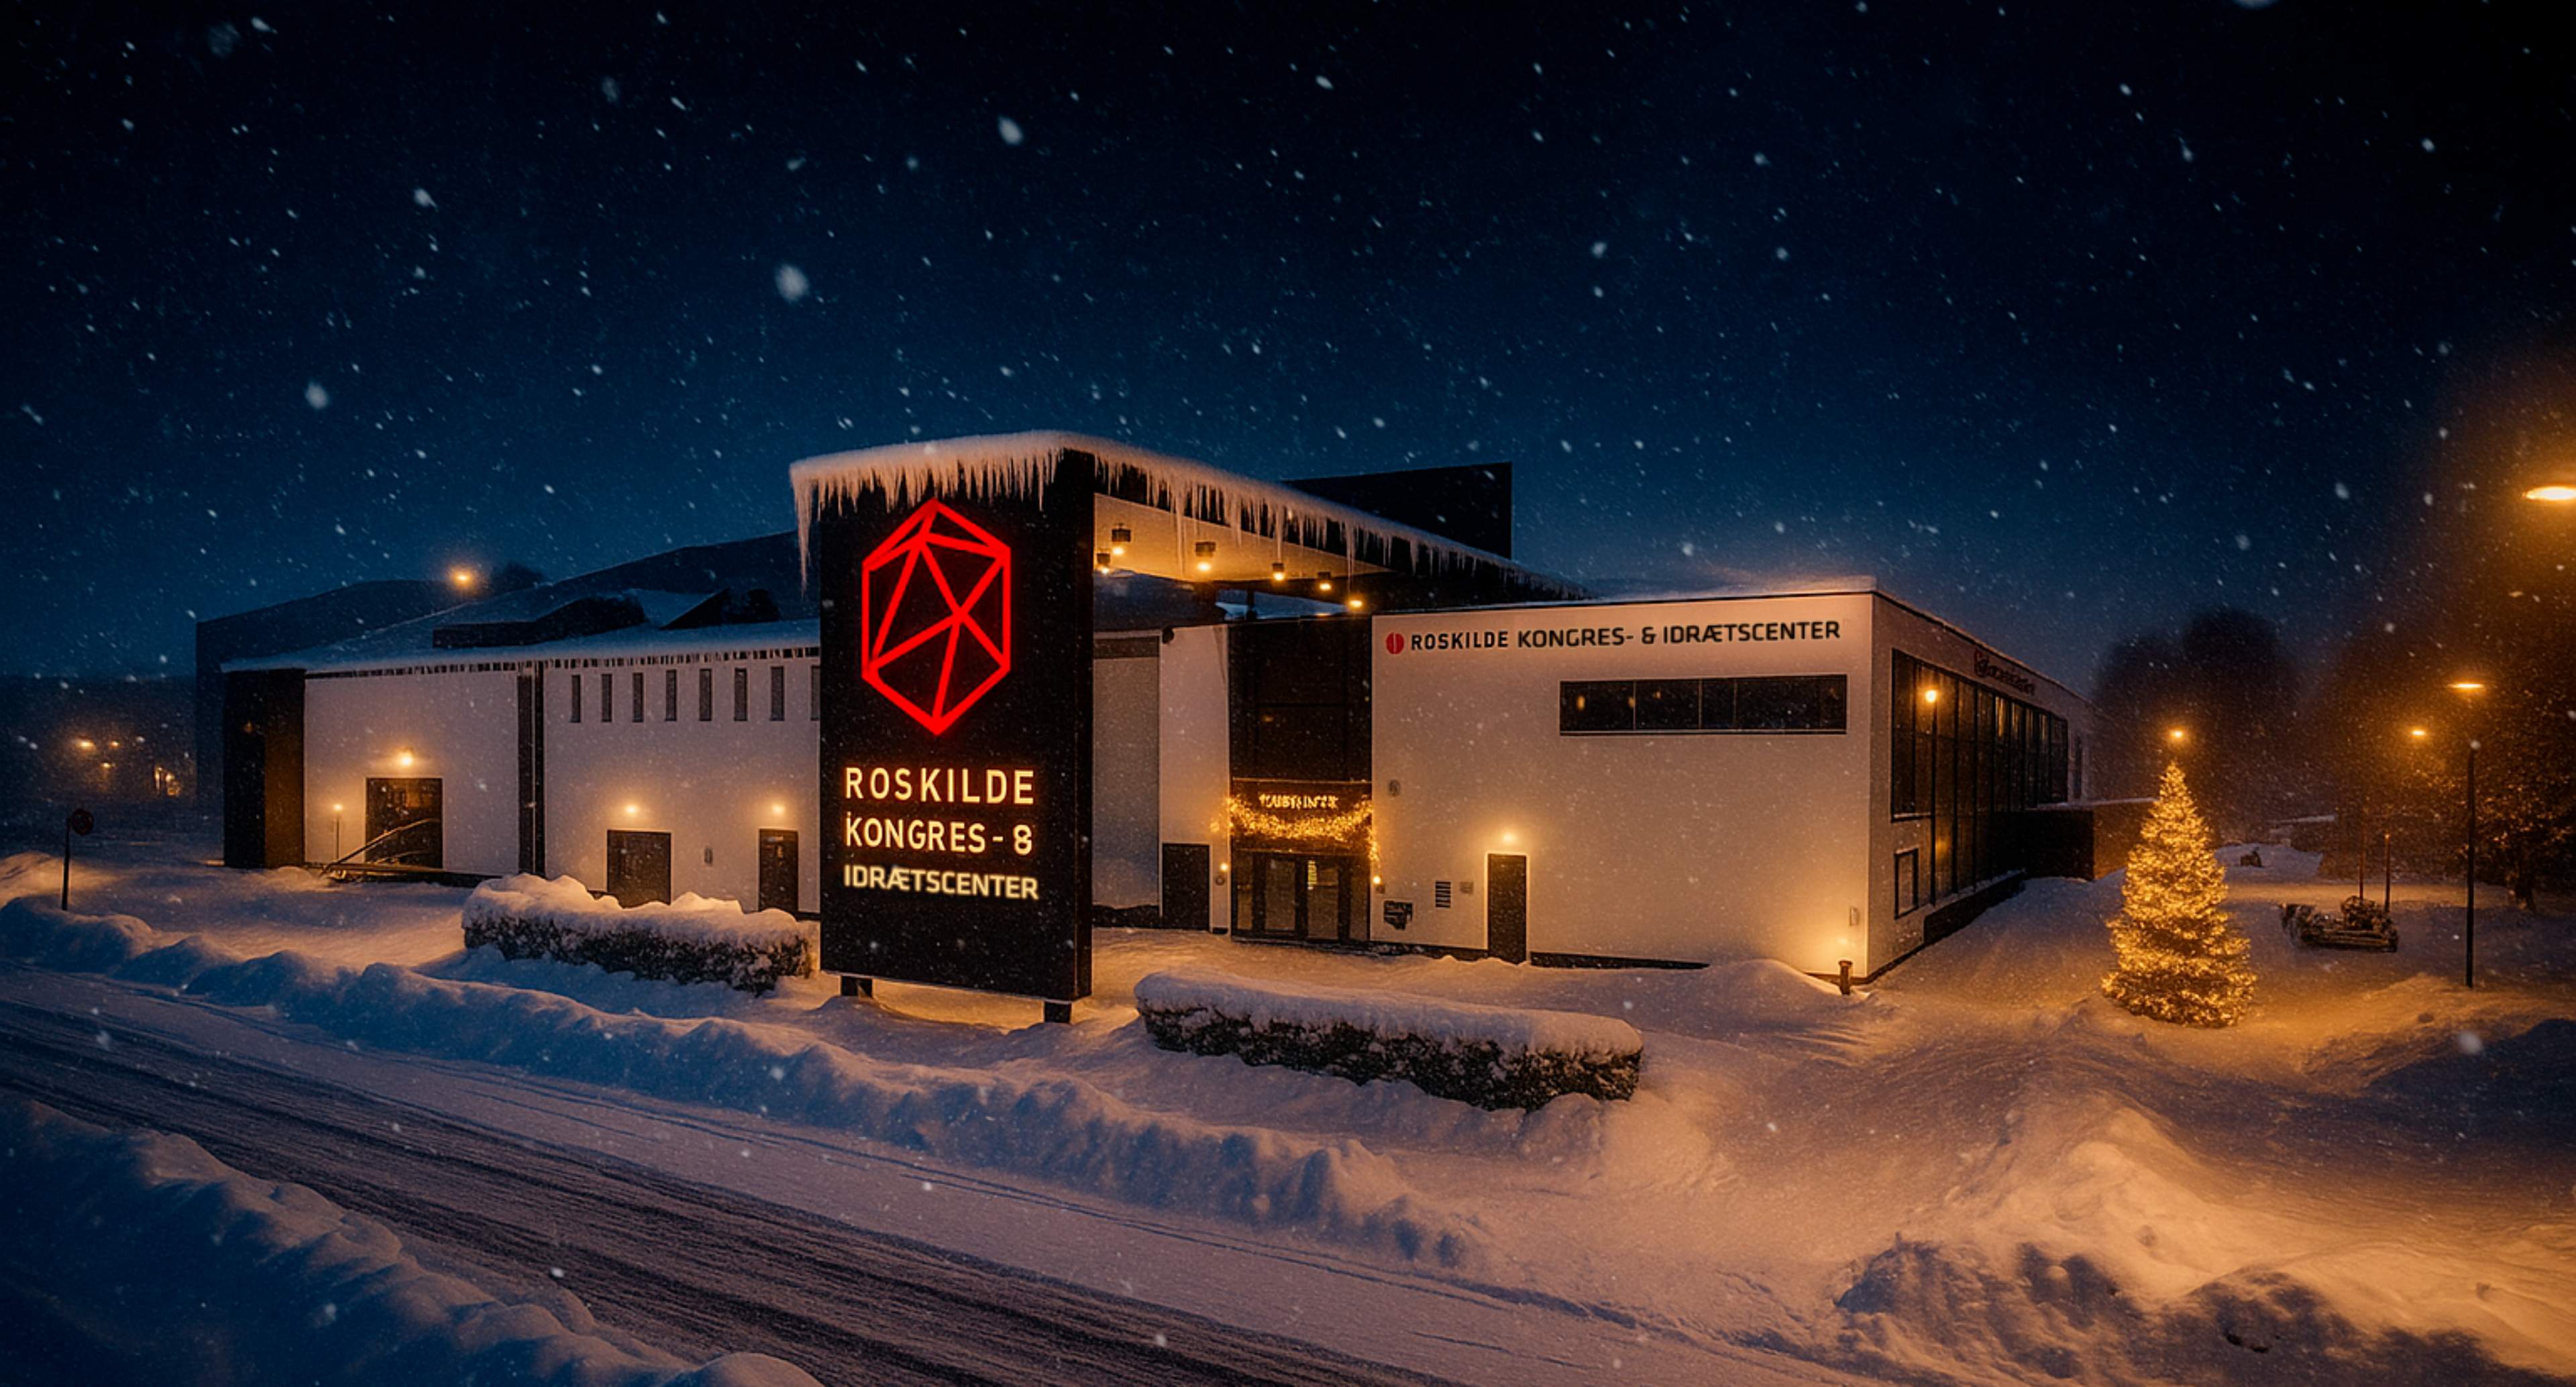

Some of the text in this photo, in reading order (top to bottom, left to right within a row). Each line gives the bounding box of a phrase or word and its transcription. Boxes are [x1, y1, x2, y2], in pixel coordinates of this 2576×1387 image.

[1411, 620, 1841, 651] ROSKILDE KONGRES- & IDRÆTSCENTER
[845, 767, 1034, 805] ROSKILDE
[843, 865, 1039, 901] IDRÆTSCENTER
